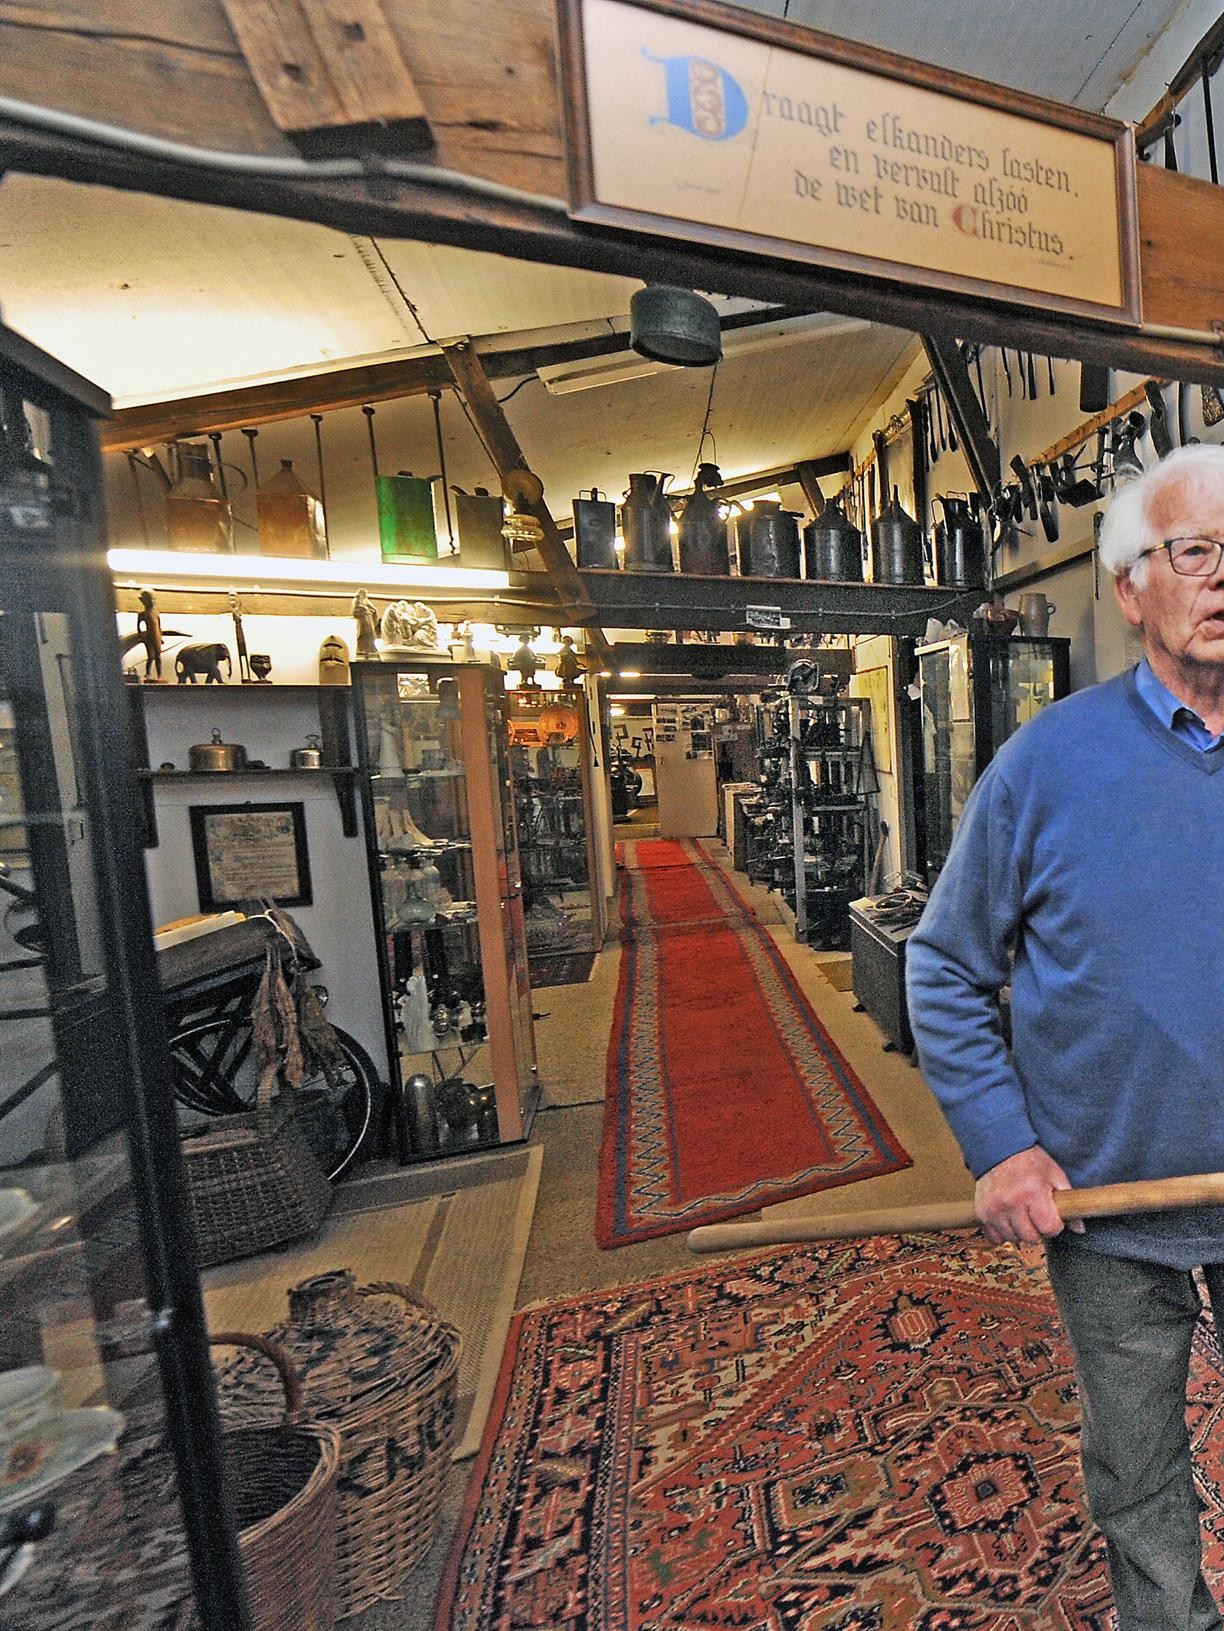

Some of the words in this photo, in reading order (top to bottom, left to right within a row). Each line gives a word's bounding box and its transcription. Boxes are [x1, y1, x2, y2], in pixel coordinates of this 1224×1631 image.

[828, 145, 860, 175] en
[794, 169, 822, 201] de
[835, 180, 882, 215] wet
[894, 193, 939, 228] van
